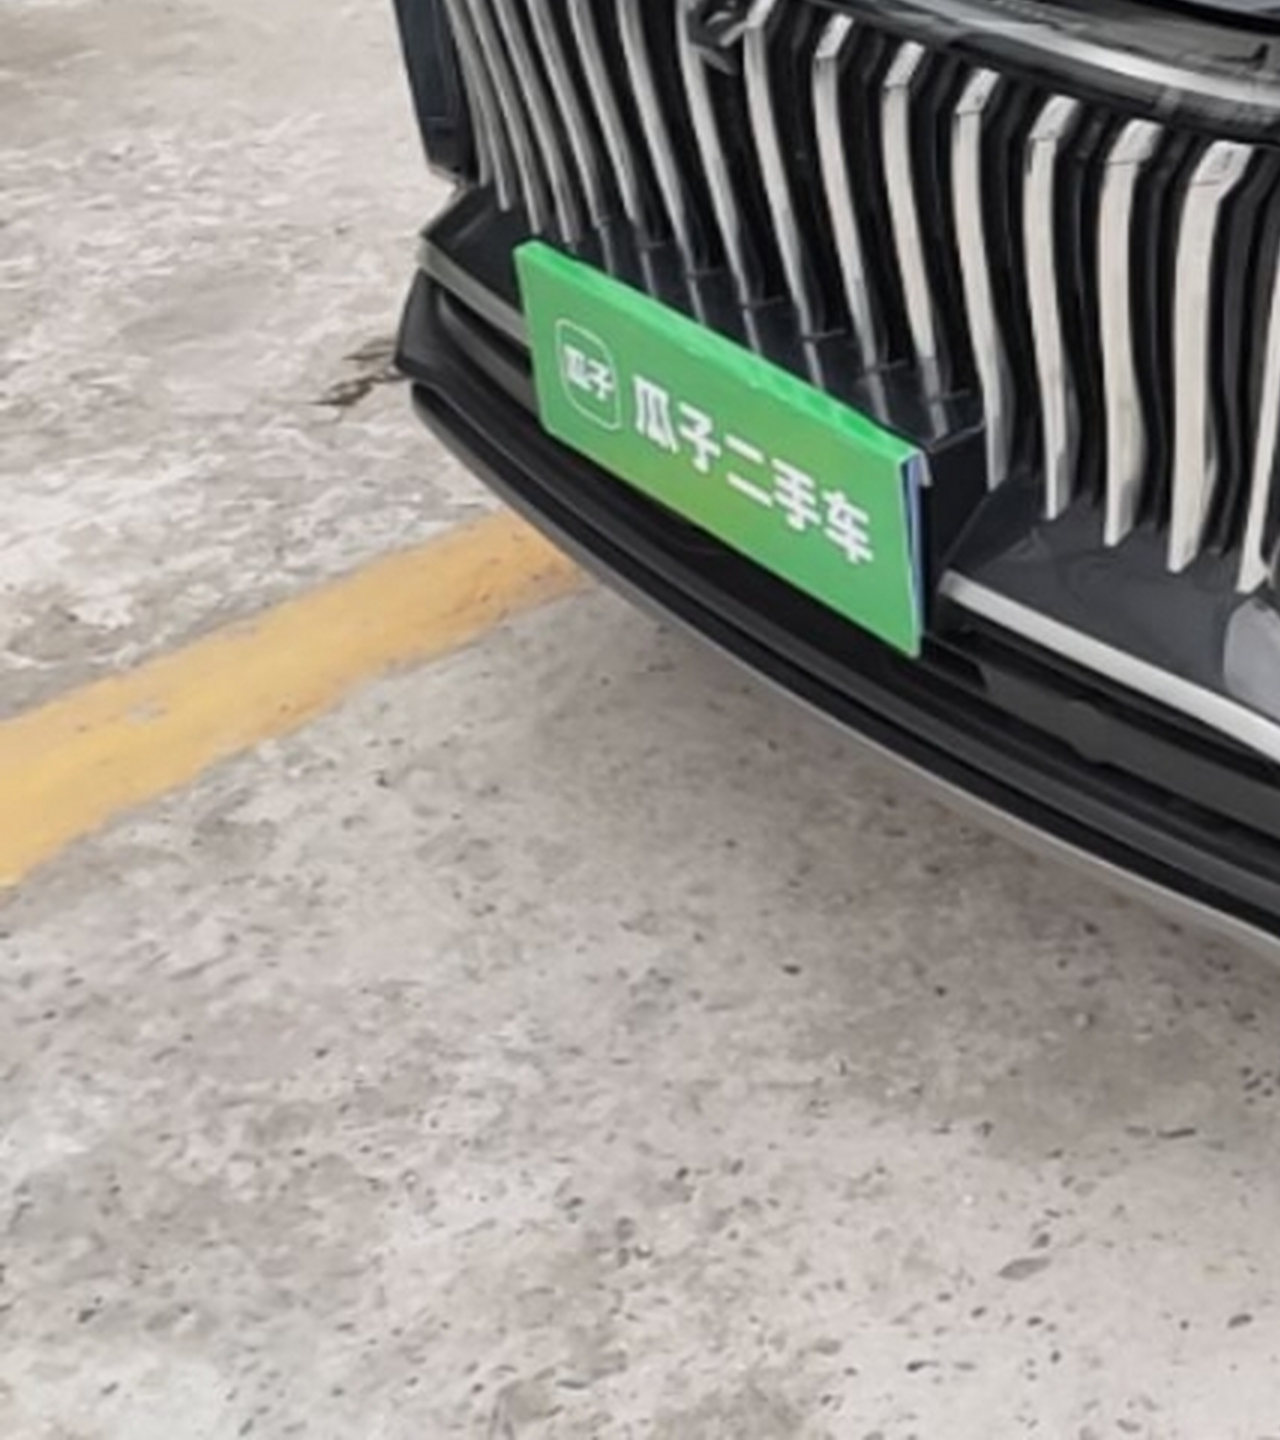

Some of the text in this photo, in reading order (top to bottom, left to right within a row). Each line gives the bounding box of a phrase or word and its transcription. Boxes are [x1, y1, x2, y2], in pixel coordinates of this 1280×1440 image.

[563, 344, 615, 401] 瓜子
[632, 374, 874, 564] 瓜子二手车
